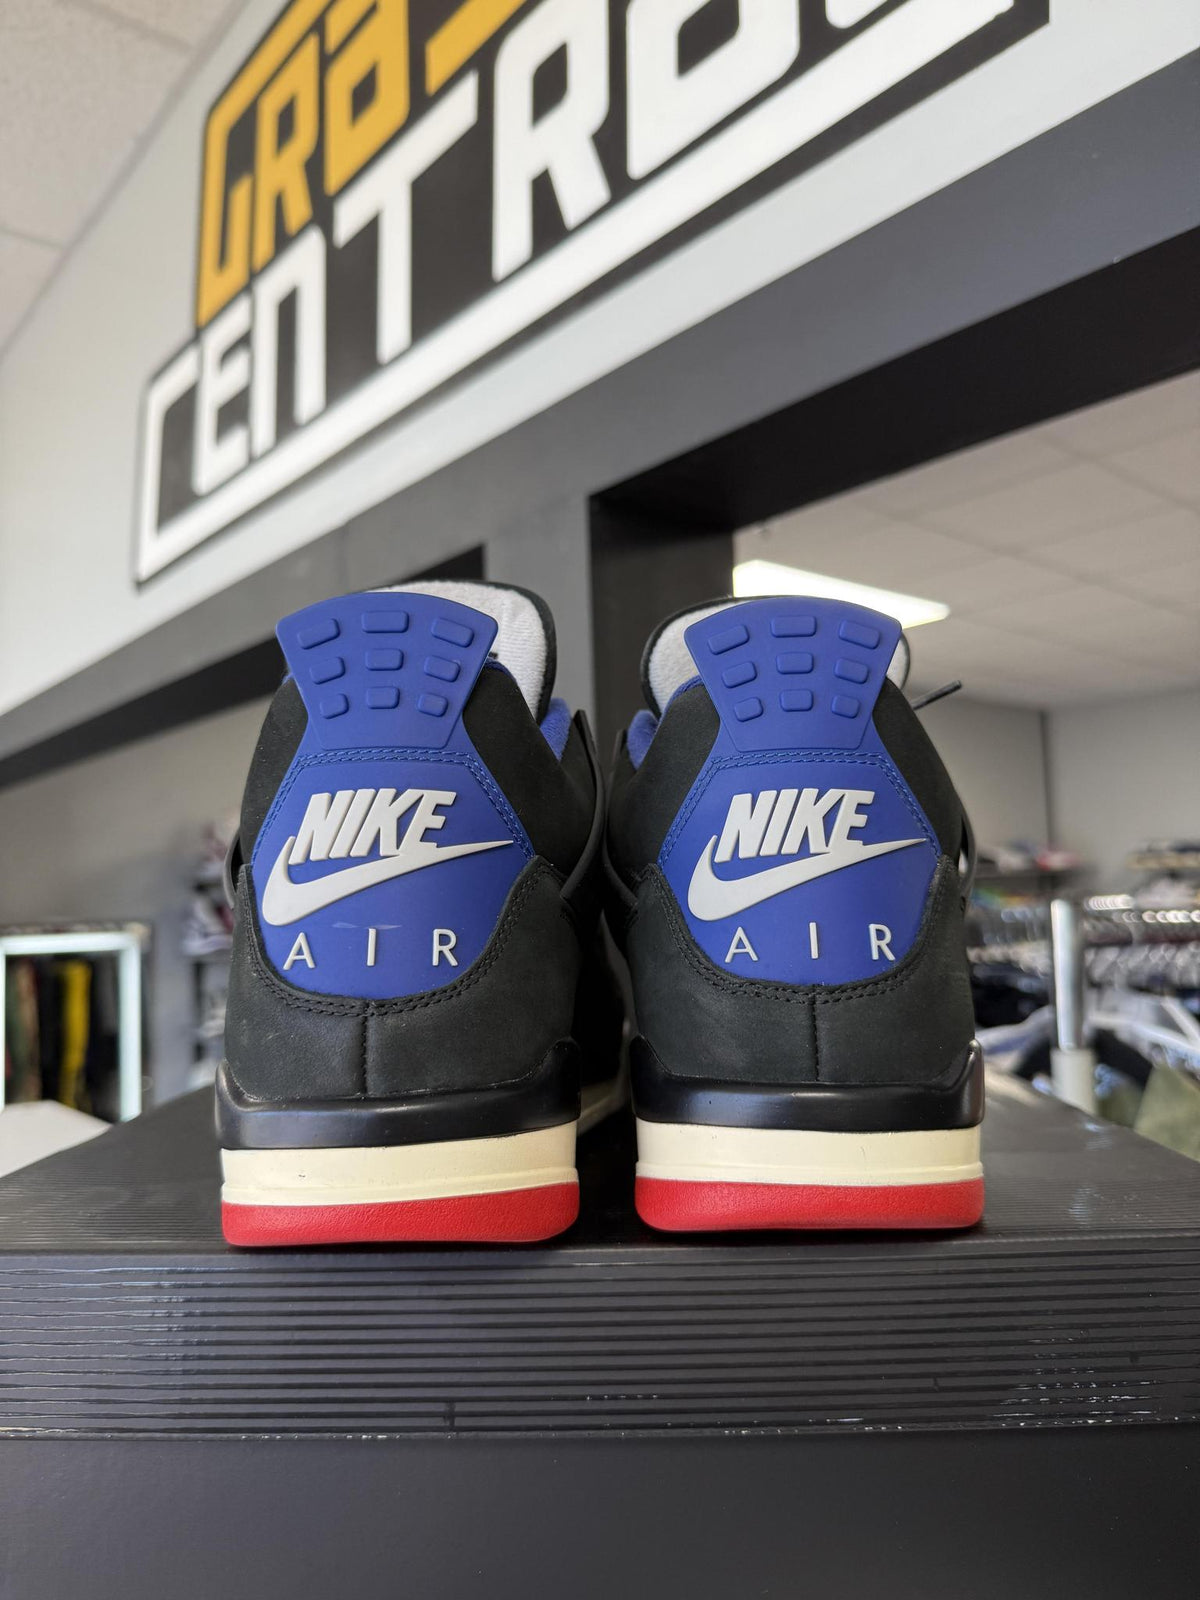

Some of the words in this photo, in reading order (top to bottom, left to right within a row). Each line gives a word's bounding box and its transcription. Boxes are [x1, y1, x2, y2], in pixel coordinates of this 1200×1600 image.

[289, 787, 457, 865] NIKE
[714, 787, 876, 864] NIKE
[283, 928, 458, 970] AIR
[725, 922, 896, 963] AIR
